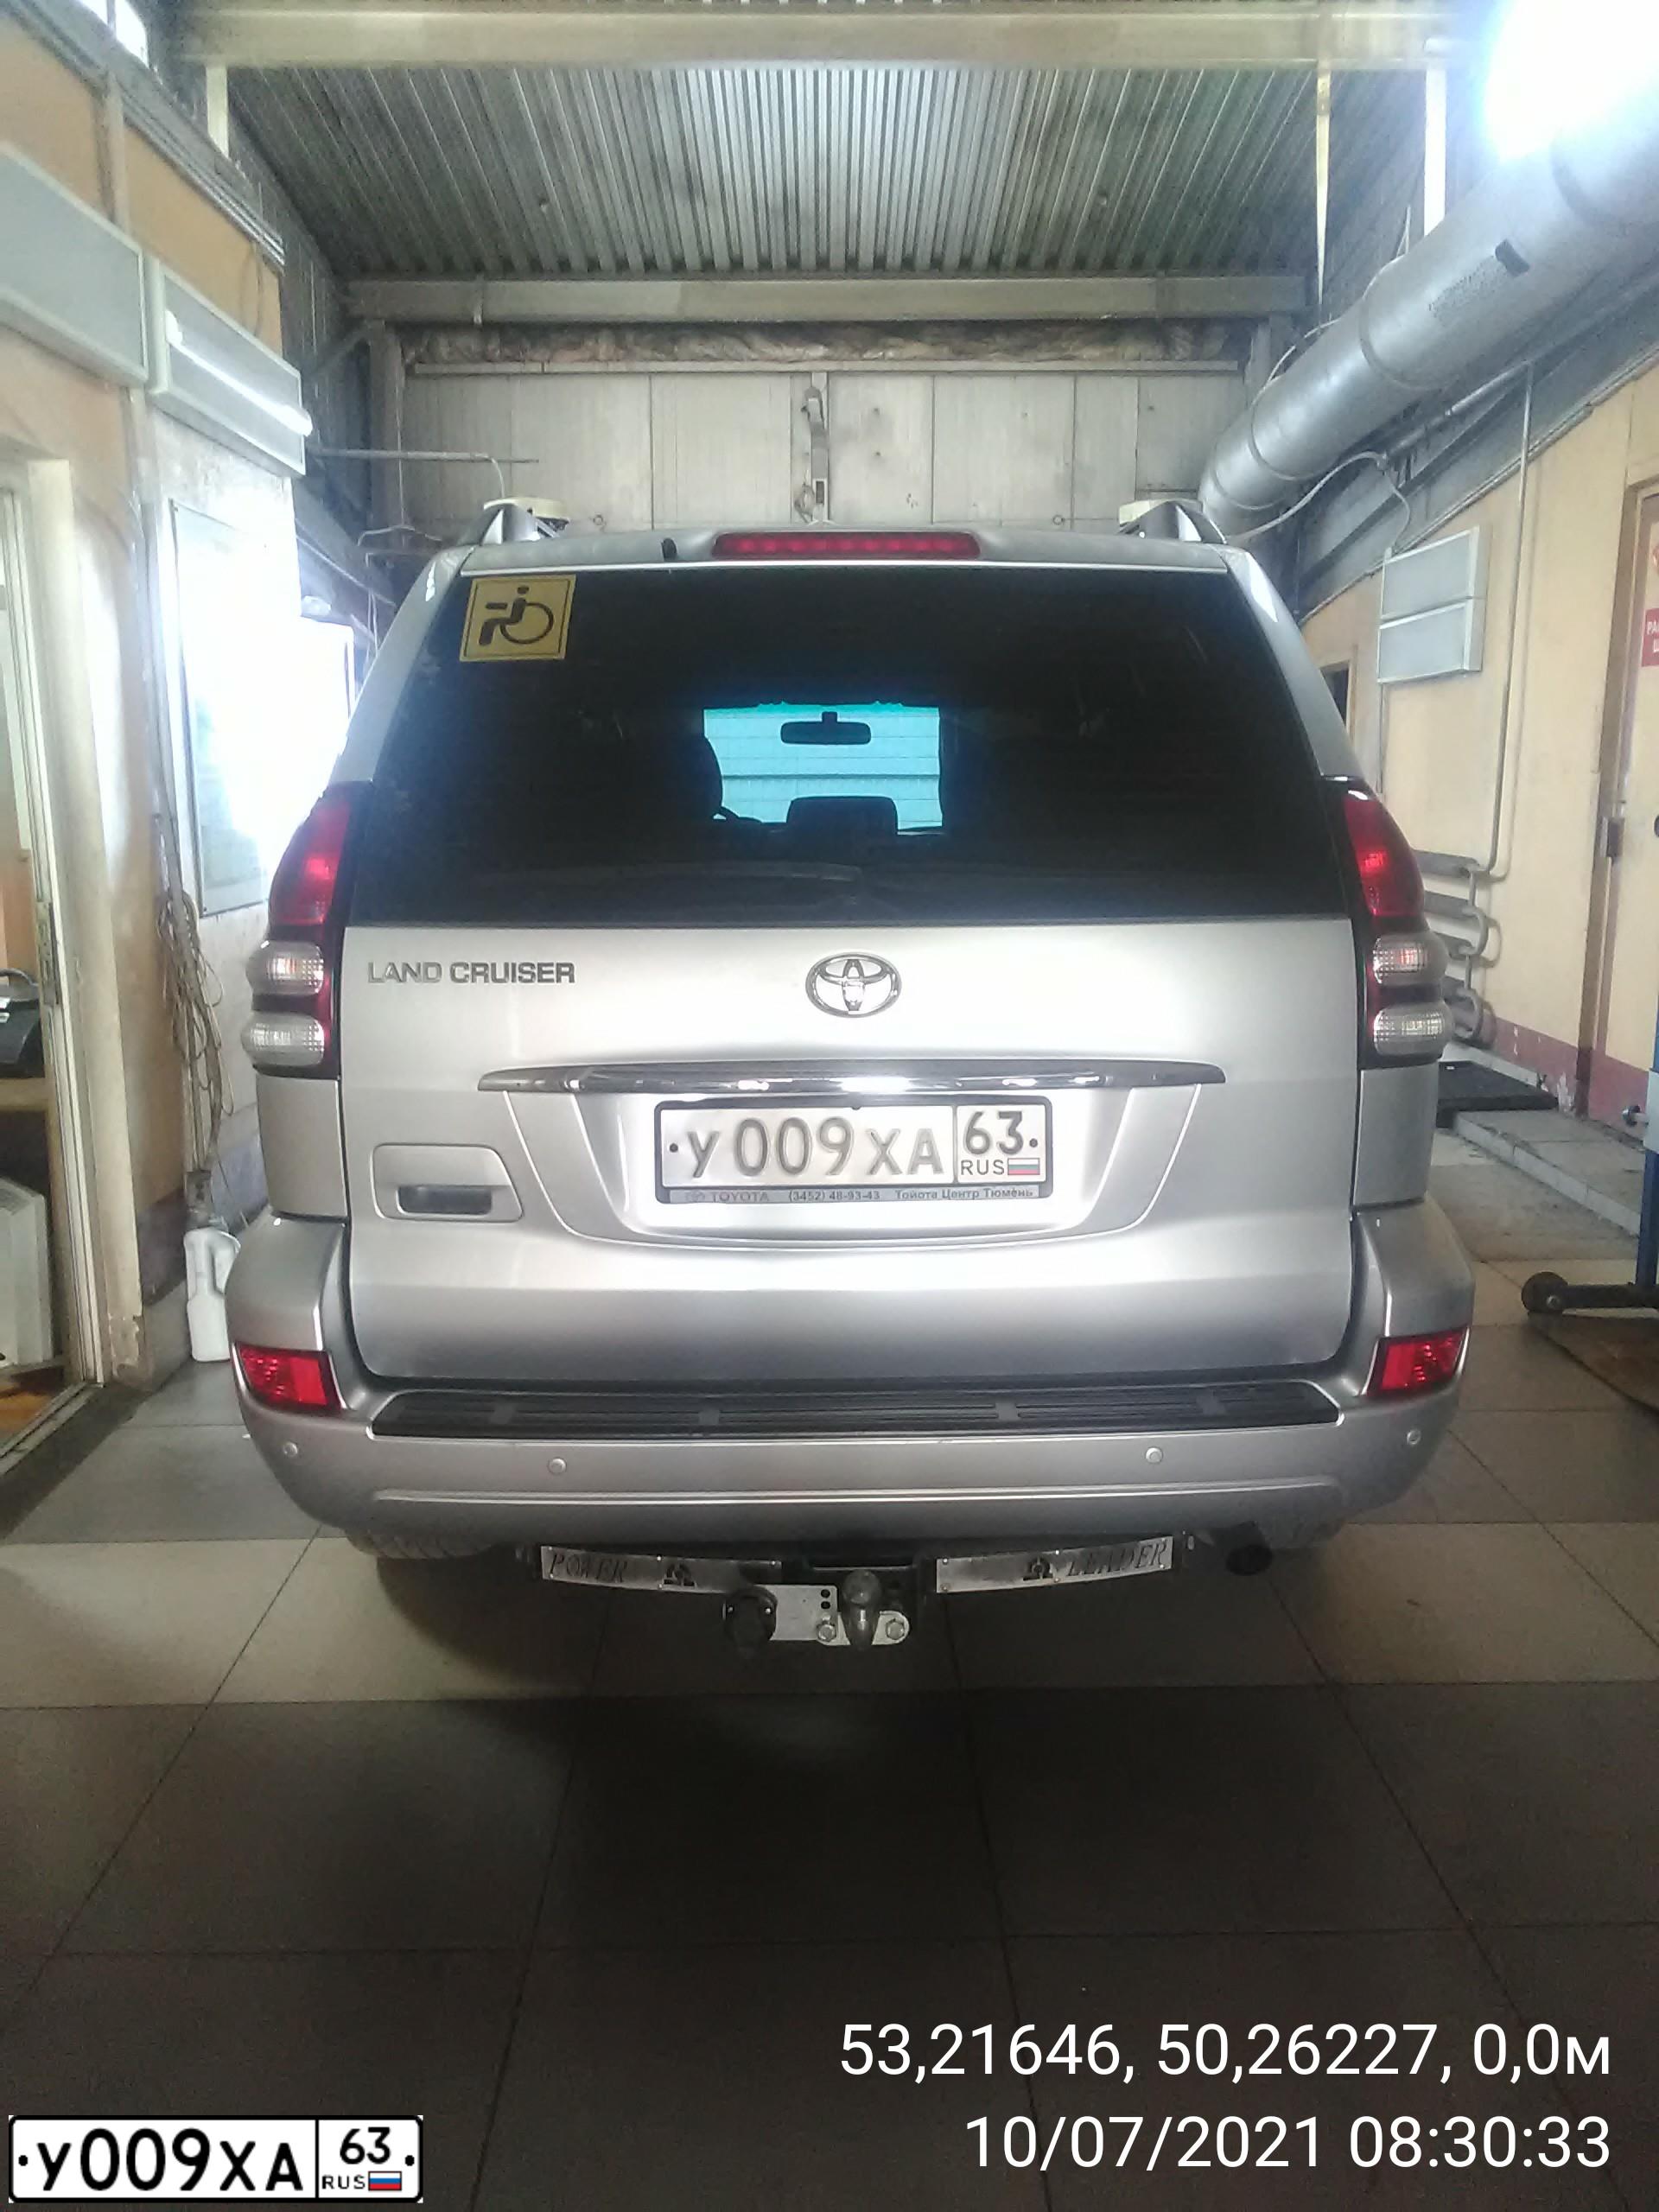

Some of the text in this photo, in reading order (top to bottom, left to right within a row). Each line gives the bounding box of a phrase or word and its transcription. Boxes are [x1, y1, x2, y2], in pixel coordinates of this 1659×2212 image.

[368, 962, 575, 983] LAND CRUISER
[688, 1110, 1024, 1178] У009ХА 63
[960, 1159, 1005, 1176] RUS
[710, 1185, 1033, 1203] TOYOTA (3452) 48-93-43 Тойота Центр Тюмень
